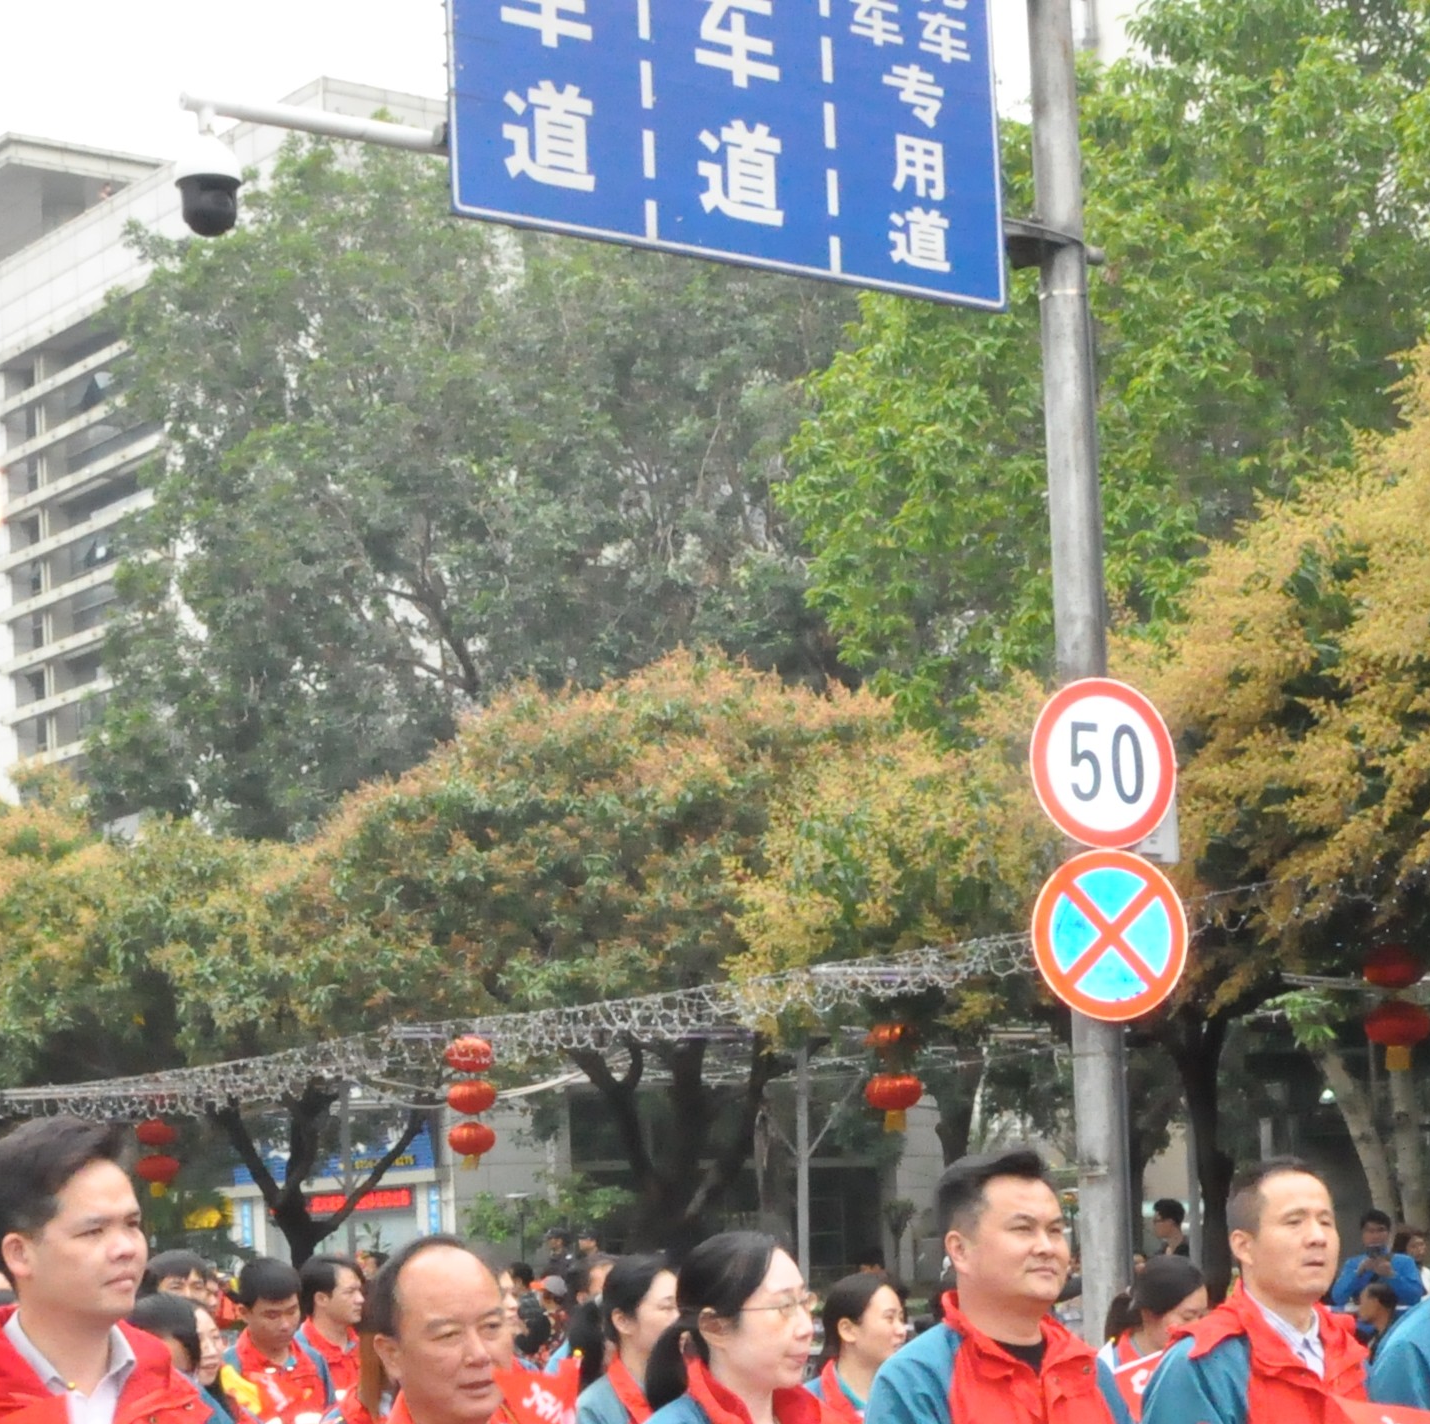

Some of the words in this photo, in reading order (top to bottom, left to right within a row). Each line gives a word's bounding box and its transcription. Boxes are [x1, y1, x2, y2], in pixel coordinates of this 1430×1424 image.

[882, 64, 951, 273] 专用道
[1071, 721, 1144, 805] 50
